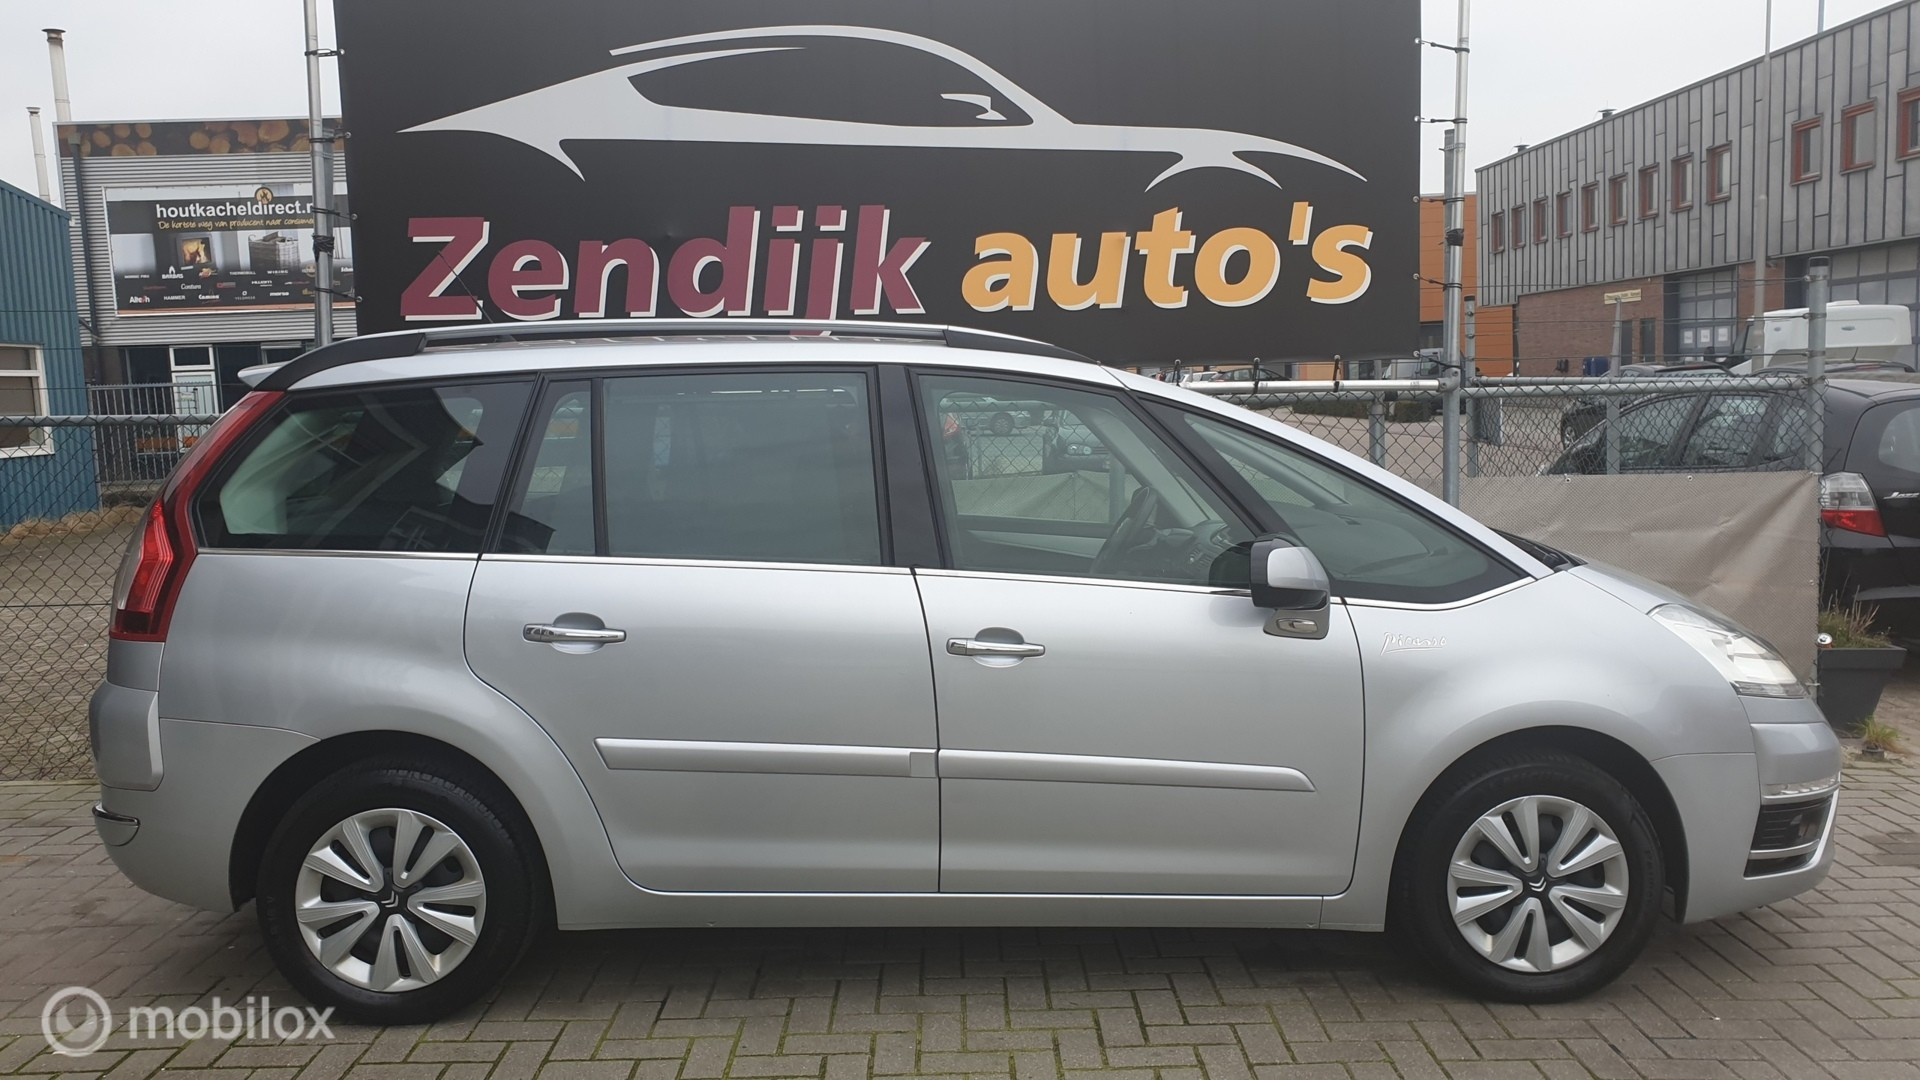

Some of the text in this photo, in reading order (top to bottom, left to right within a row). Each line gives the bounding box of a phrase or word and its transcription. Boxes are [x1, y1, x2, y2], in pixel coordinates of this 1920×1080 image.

[156, 200, 313, 219] houtkacheldirect.n
[157, 220, 170, 230] De
[171, 220, 196, 229] kortste
[198, 220, 213, 231] weg
[229, 218, 264, 230] producent
[265, 218, 282, 226] naar
[400, 202, 1374, 336] Zendijk auto's
